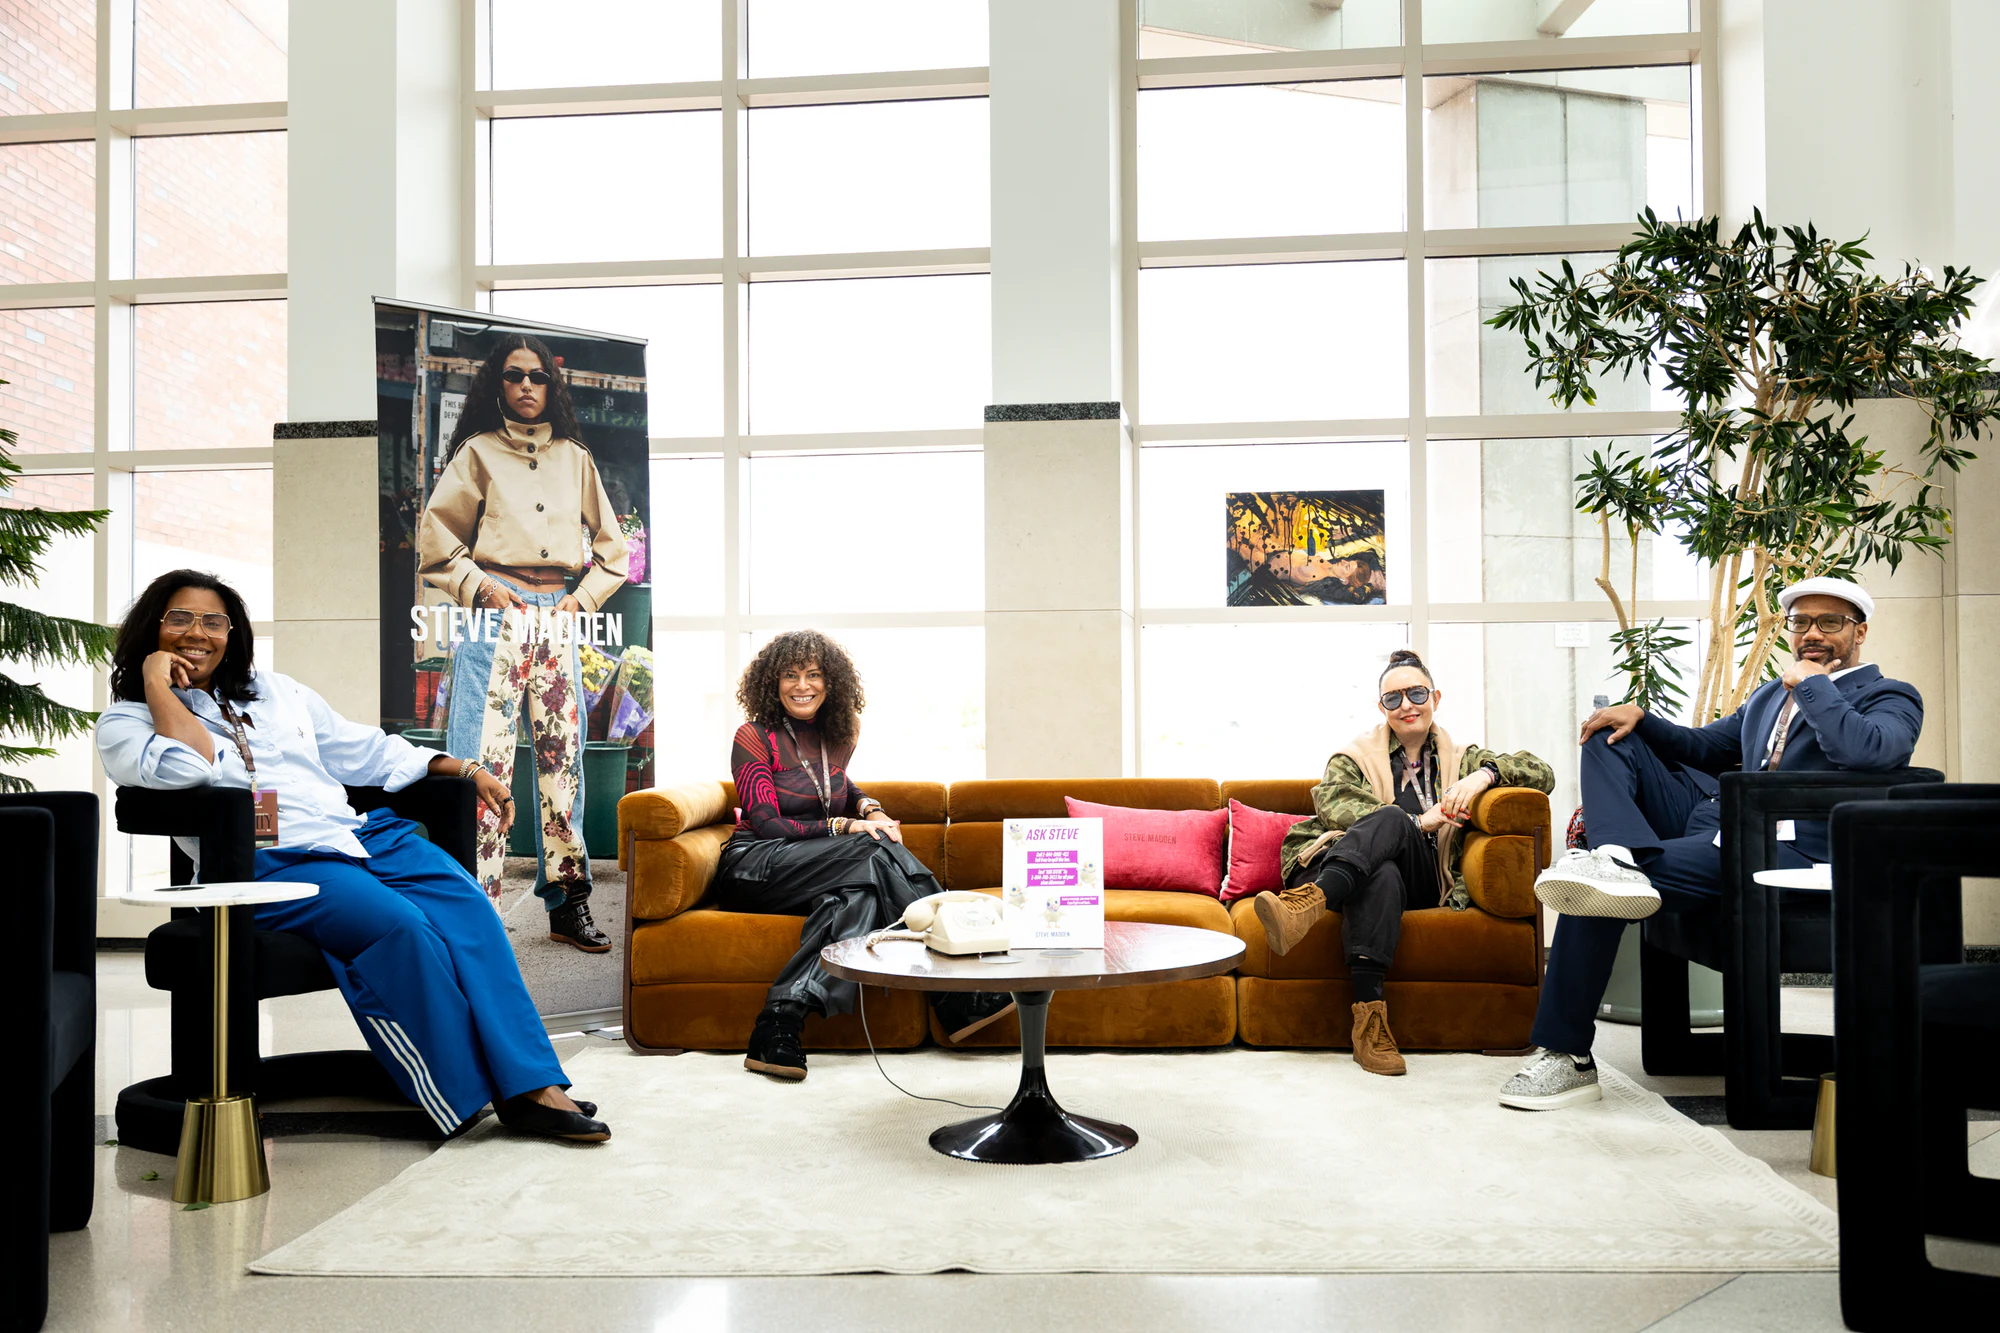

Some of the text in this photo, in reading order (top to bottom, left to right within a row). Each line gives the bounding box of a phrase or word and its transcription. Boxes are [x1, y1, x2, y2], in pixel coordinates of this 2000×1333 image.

[444, 400, 457, 409] THIS
[410, 605, 500, 643] STEVE
[511, 608, 623, 646] MADDEN
[1026, 828, 1079, 840] ASK STEVE
[1124, 832, 1177, 844] STEVE MADDEN
